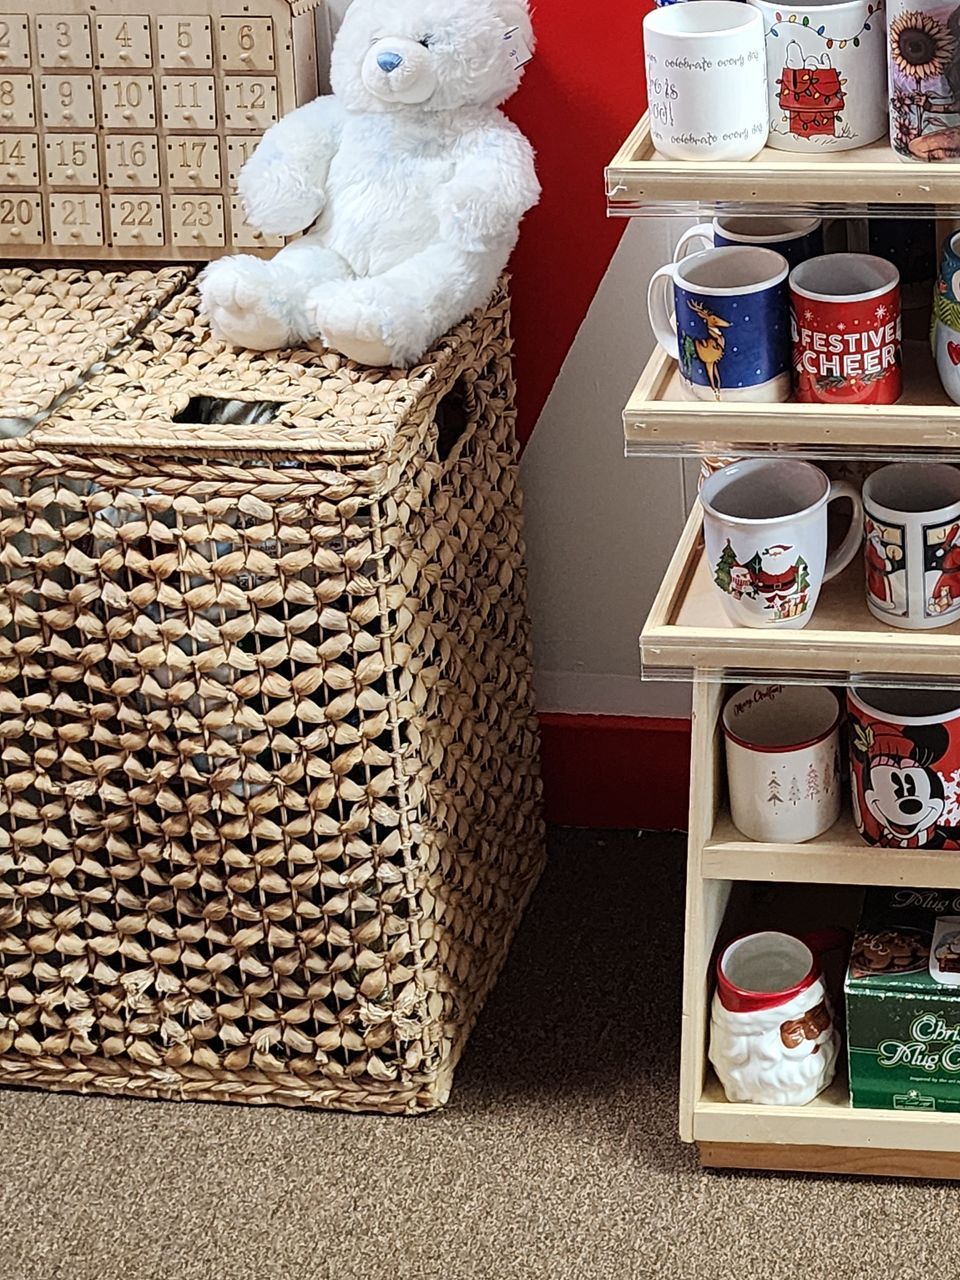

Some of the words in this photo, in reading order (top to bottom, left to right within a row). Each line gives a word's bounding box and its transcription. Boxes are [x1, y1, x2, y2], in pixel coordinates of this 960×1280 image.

[56, 22, 72, 48] 3
[115, 21, 133, 48] 4
[176, 22, 193, 48] 5
[237, 24, 255, 51] 6
[0, 80, 15, 106] 8
[59, 81, 73, 107] 9
[113, 81, 143, 108] 10
[173, 82, 202, 108] 11
[236, 82, 266, 109] 12
[0, 140, 27, 166] 14
[56, 140, 87, 167] 15
[117, 141, 147, 167] 16
[178, 141, 207, 168] 17
[239, 141, 259, 168] 1
[0, 199, 33, 226] 20
[62, 200, 91, 226] 21
[120, 200, 153, 227] 22
[181, 201, 214, 227] 23
[801, 321, 896, 354] FESTIVE
[802, 344, 896, 377] CHEER
[892, 890, 946, 913] Mug
[879, 1040, 940, 1071] Mug
